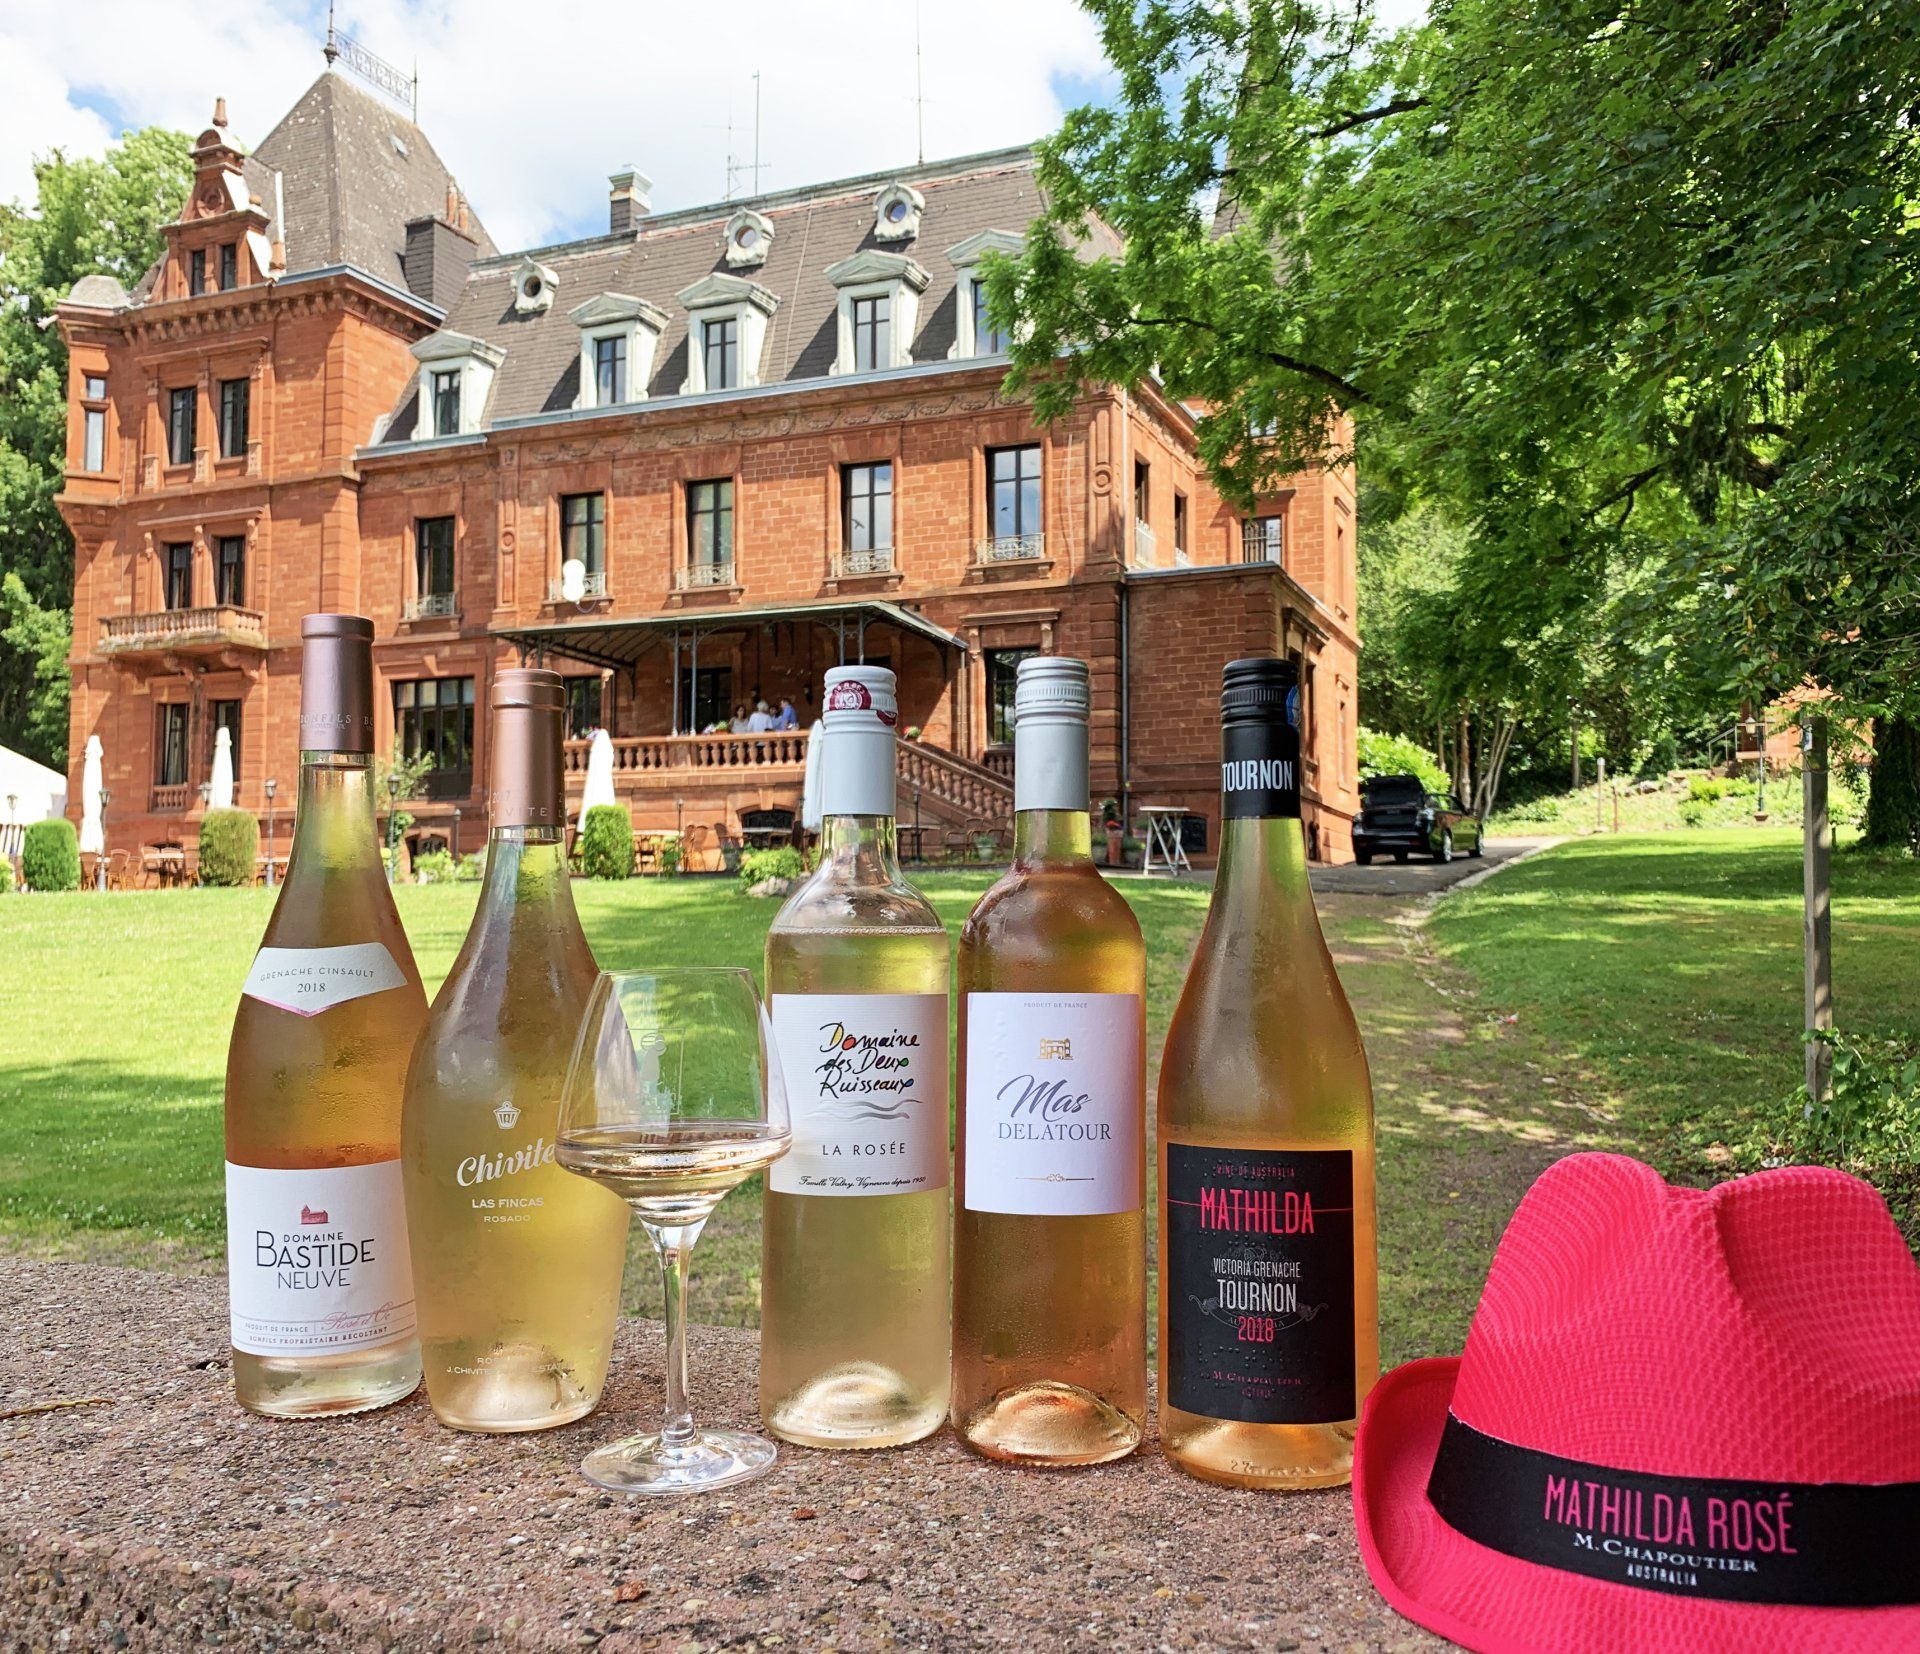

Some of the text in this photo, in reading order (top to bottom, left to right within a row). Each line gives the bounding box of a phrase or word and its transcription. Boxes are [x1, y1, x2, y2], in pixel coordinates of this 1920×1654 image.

[1221, 760, 1294, 792] TOURNON
[260, 967, 376, 982] GRENACHE CINSAULT
[297, 983, 326, 993] 2018
[820, 1021, 920, 1052] Domaine
[824, 1047, 909, 1075] des Deux
[815, 1064, 915, 1099] Ruisseaux
[997, 1075, 1092, 1122] Mas
[998, 1122, 1112, 1141] DELATOUR
[823, 1141, 906, 1156] LA ROSÉE
[456, 1138, 556, 1187] Chivite
[891, 1178, 911, 1187] depuis
[472, 1198, 544, 1208] LAS FINCAS
[1201, 1187, 1315, 1233] MATHILDA
[484, 1215, 531, 1223] ROSADO
[256, 1230, 375, 1269] BASTIDE
[283, 1231, 344, 1243] DOMAINE
[278, 1268, 350, 1289] NEUVE
[1213, 1257, 1301, 1278] VICTORIA GRENACHE
[1217, 1279, 1297, 1313] TOURNON
[1238, 1315, 1273, 1342] 2018
[1543, 1474, 1798, 1555] MATHILDA ROSÉ
[1626, 1563, 1698, 1587] AUSTRALIA
